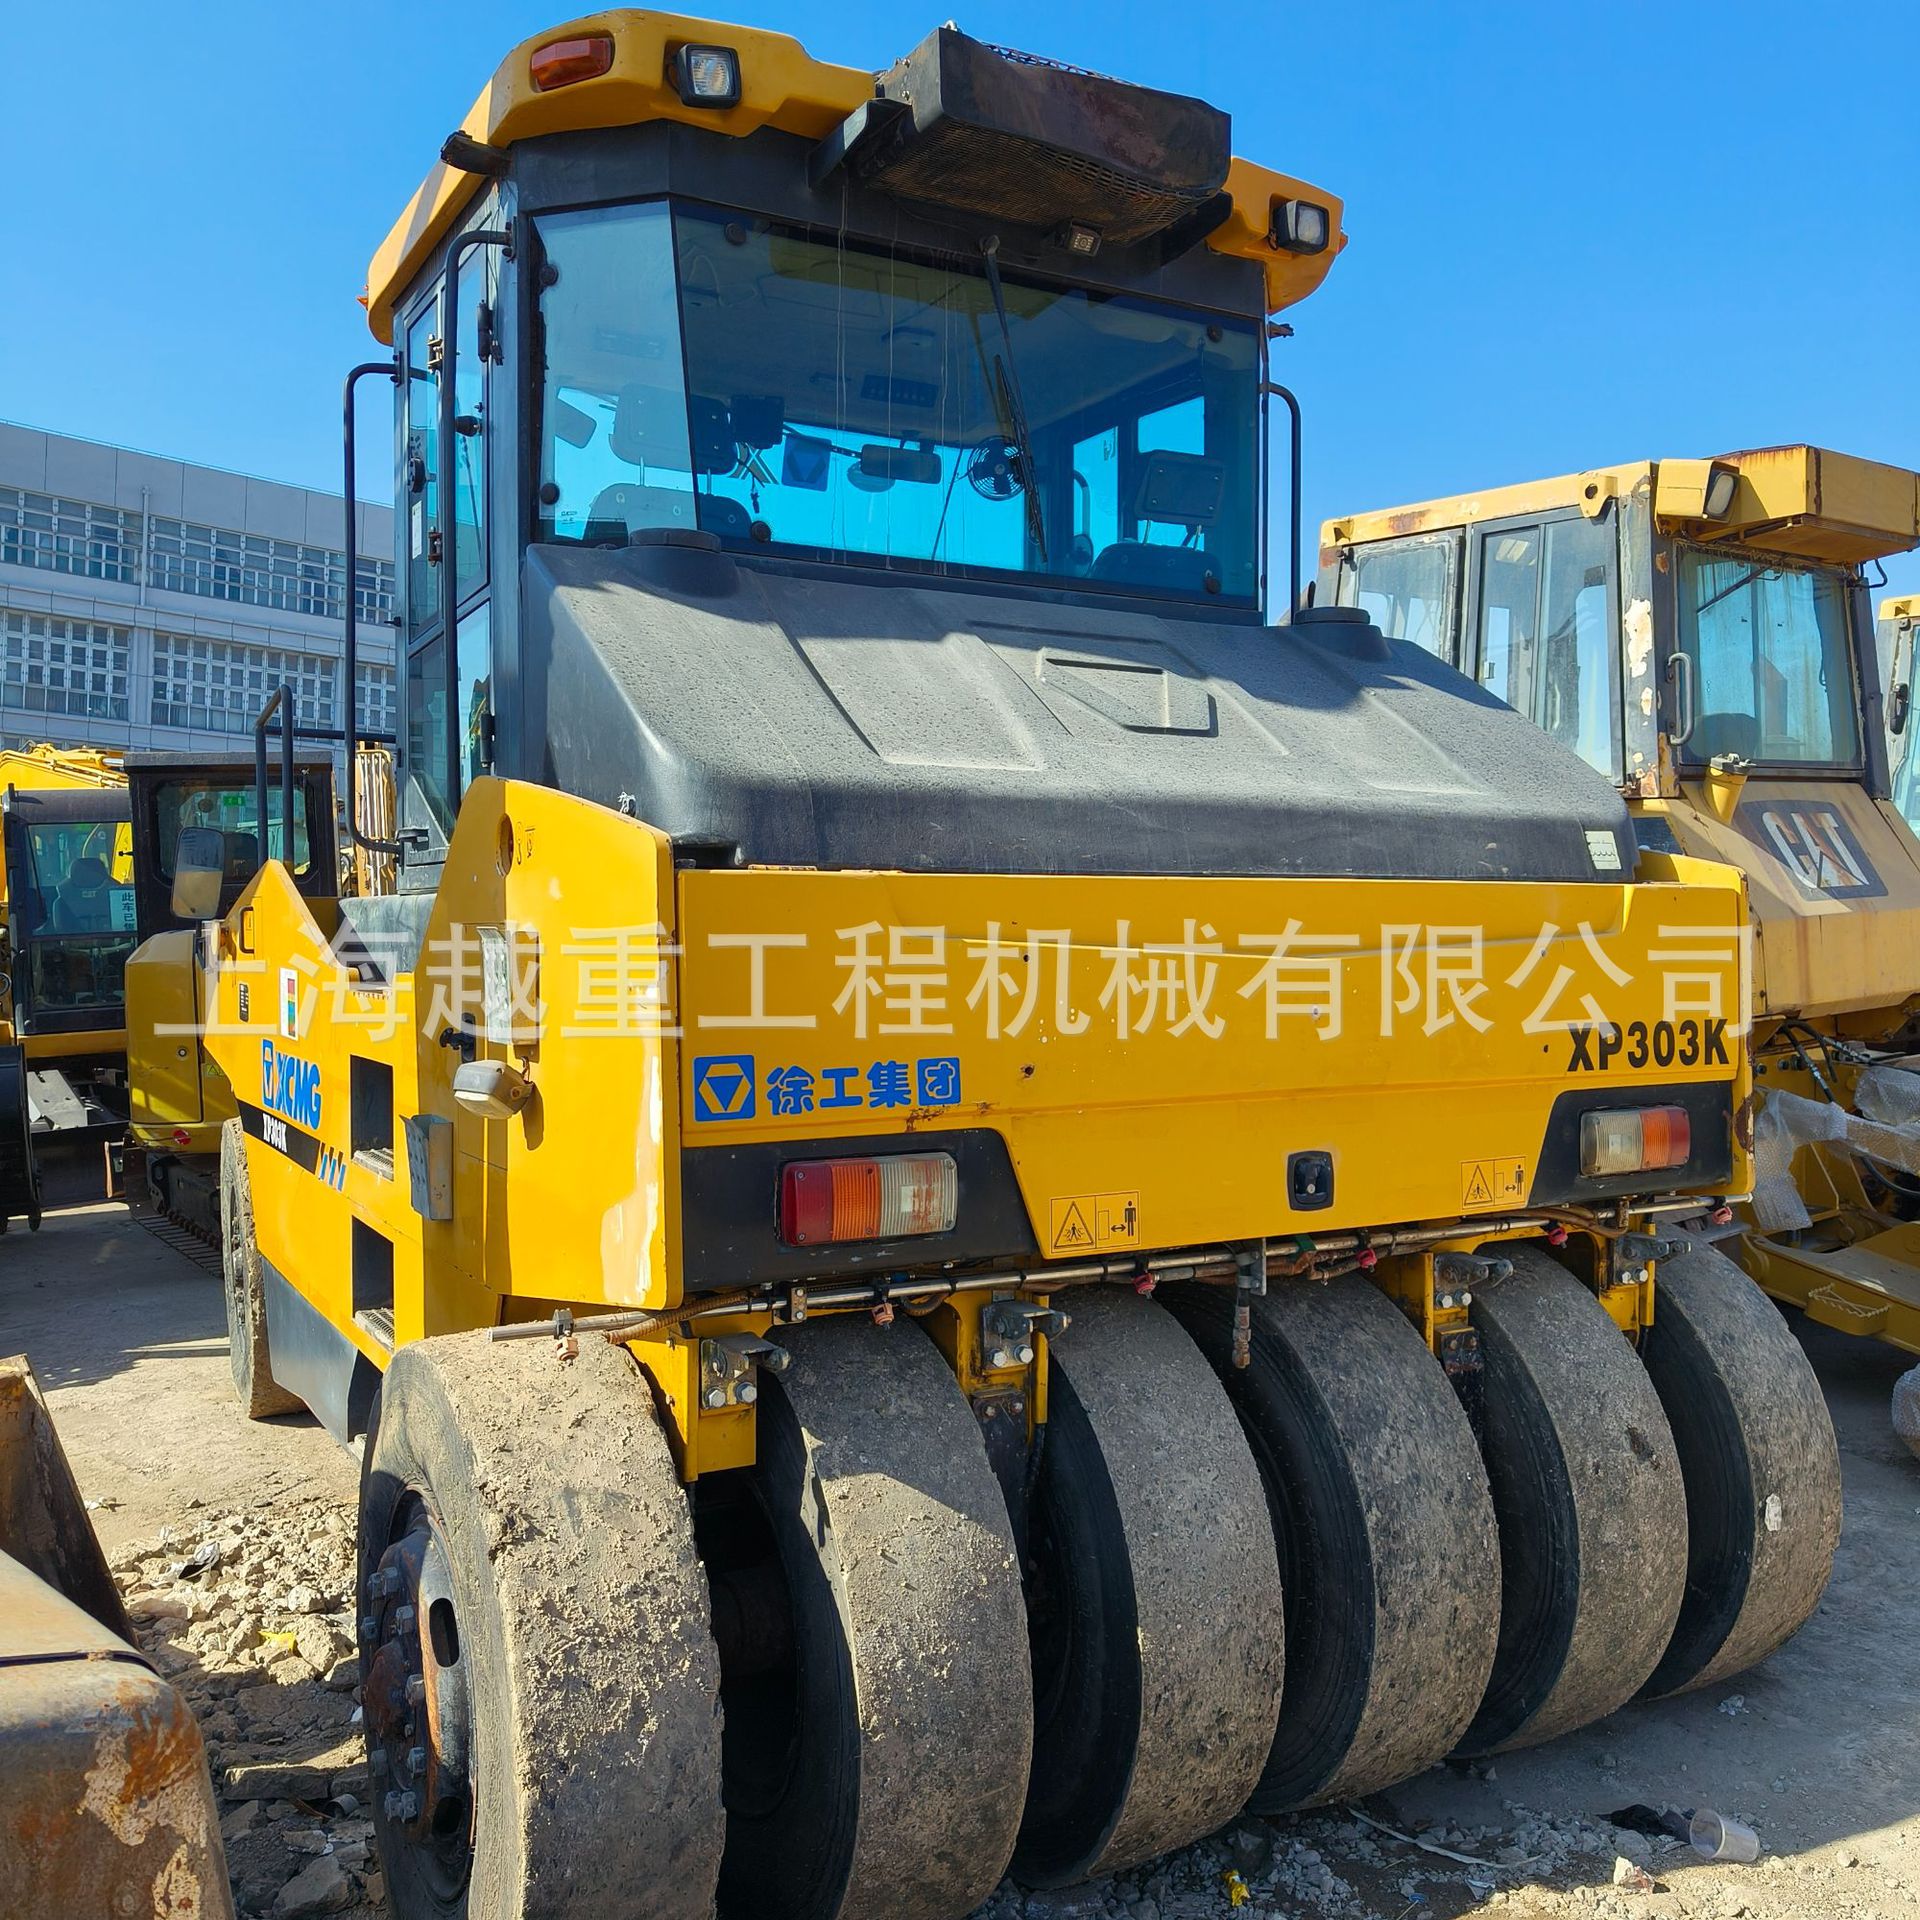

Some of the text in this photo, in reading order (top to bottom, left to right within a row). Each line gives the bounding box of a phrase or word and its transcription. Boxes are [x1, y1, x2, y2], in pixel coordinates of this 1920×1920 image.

[1762, 811, 1870, 888] CAT
[1567, 1019, 1730, 1073] XP303K
[275, 1052, 321, 1131] XCMG
[766, 1057, 961, 1117] 徐工集团
